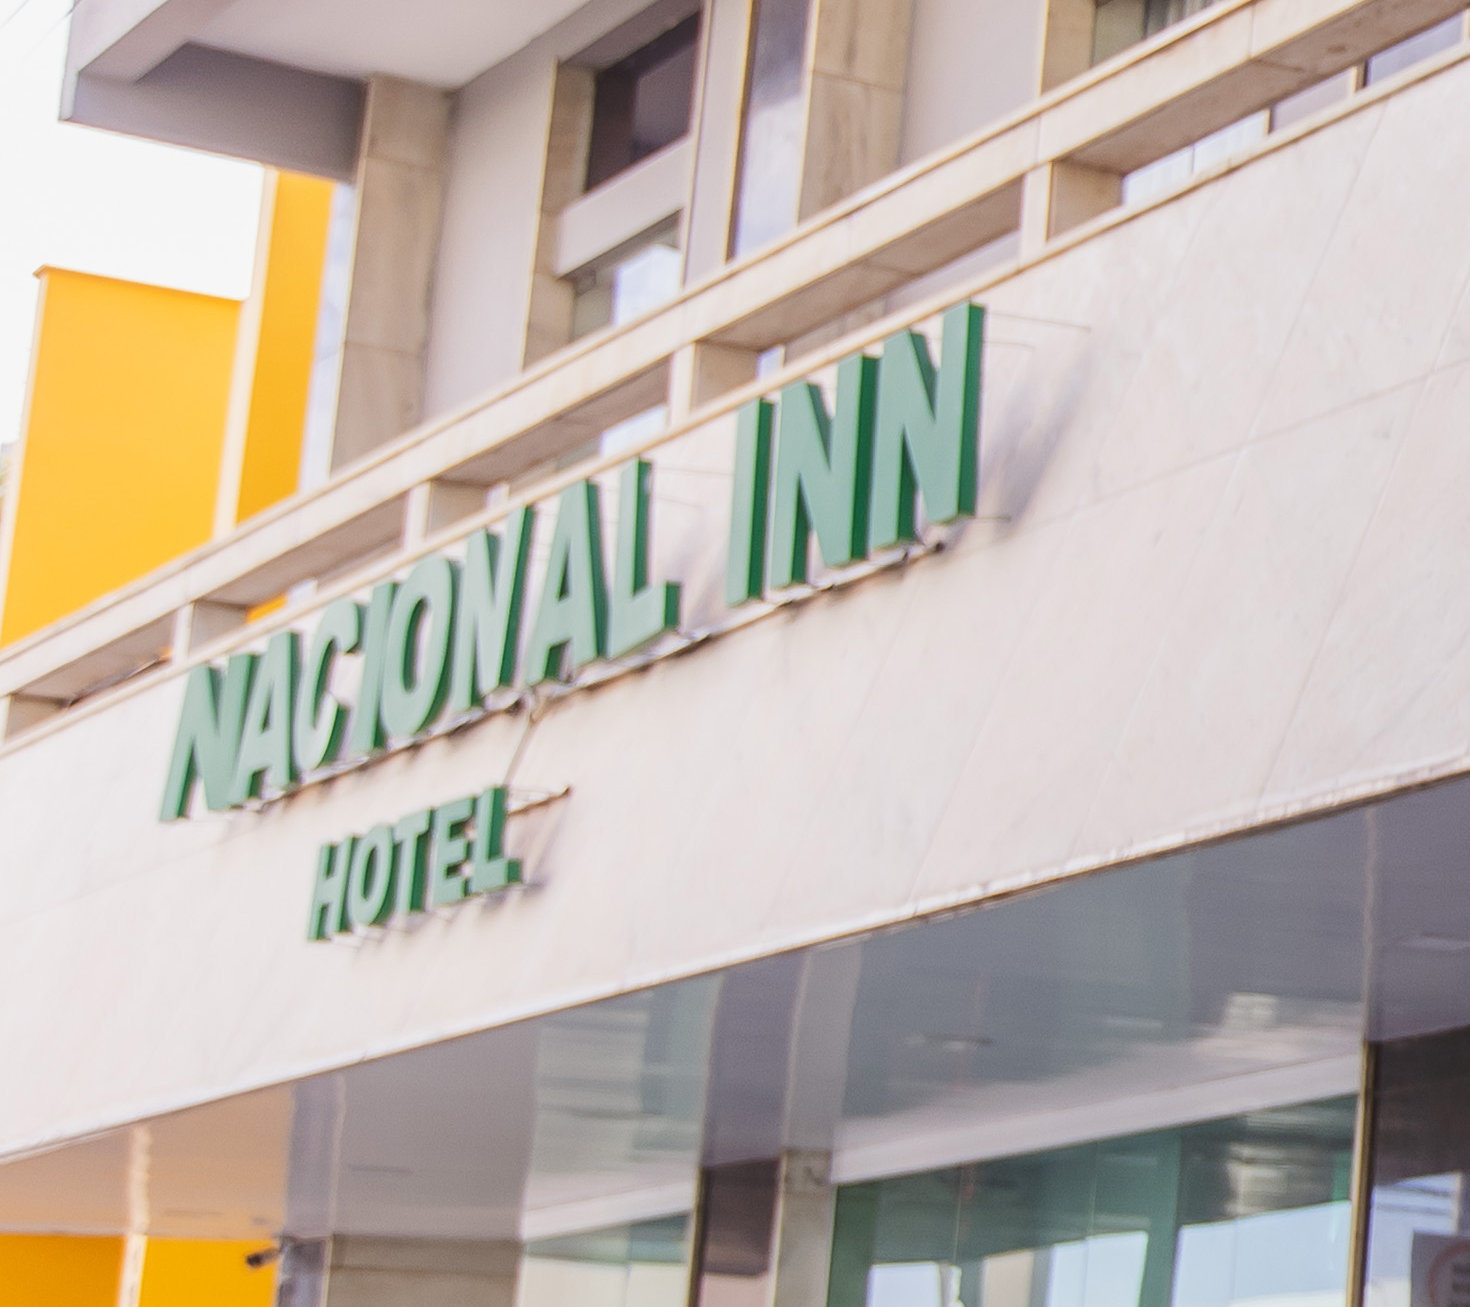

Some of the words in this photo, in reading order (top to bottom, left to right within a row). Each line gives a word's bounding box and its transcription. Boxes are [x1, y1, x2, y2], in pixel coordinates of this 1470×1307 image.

[160, 459, 680, 823] NACIONAL
[726, 301, 986, 607] INN
[306, 786, 522, 942] HOTEL
